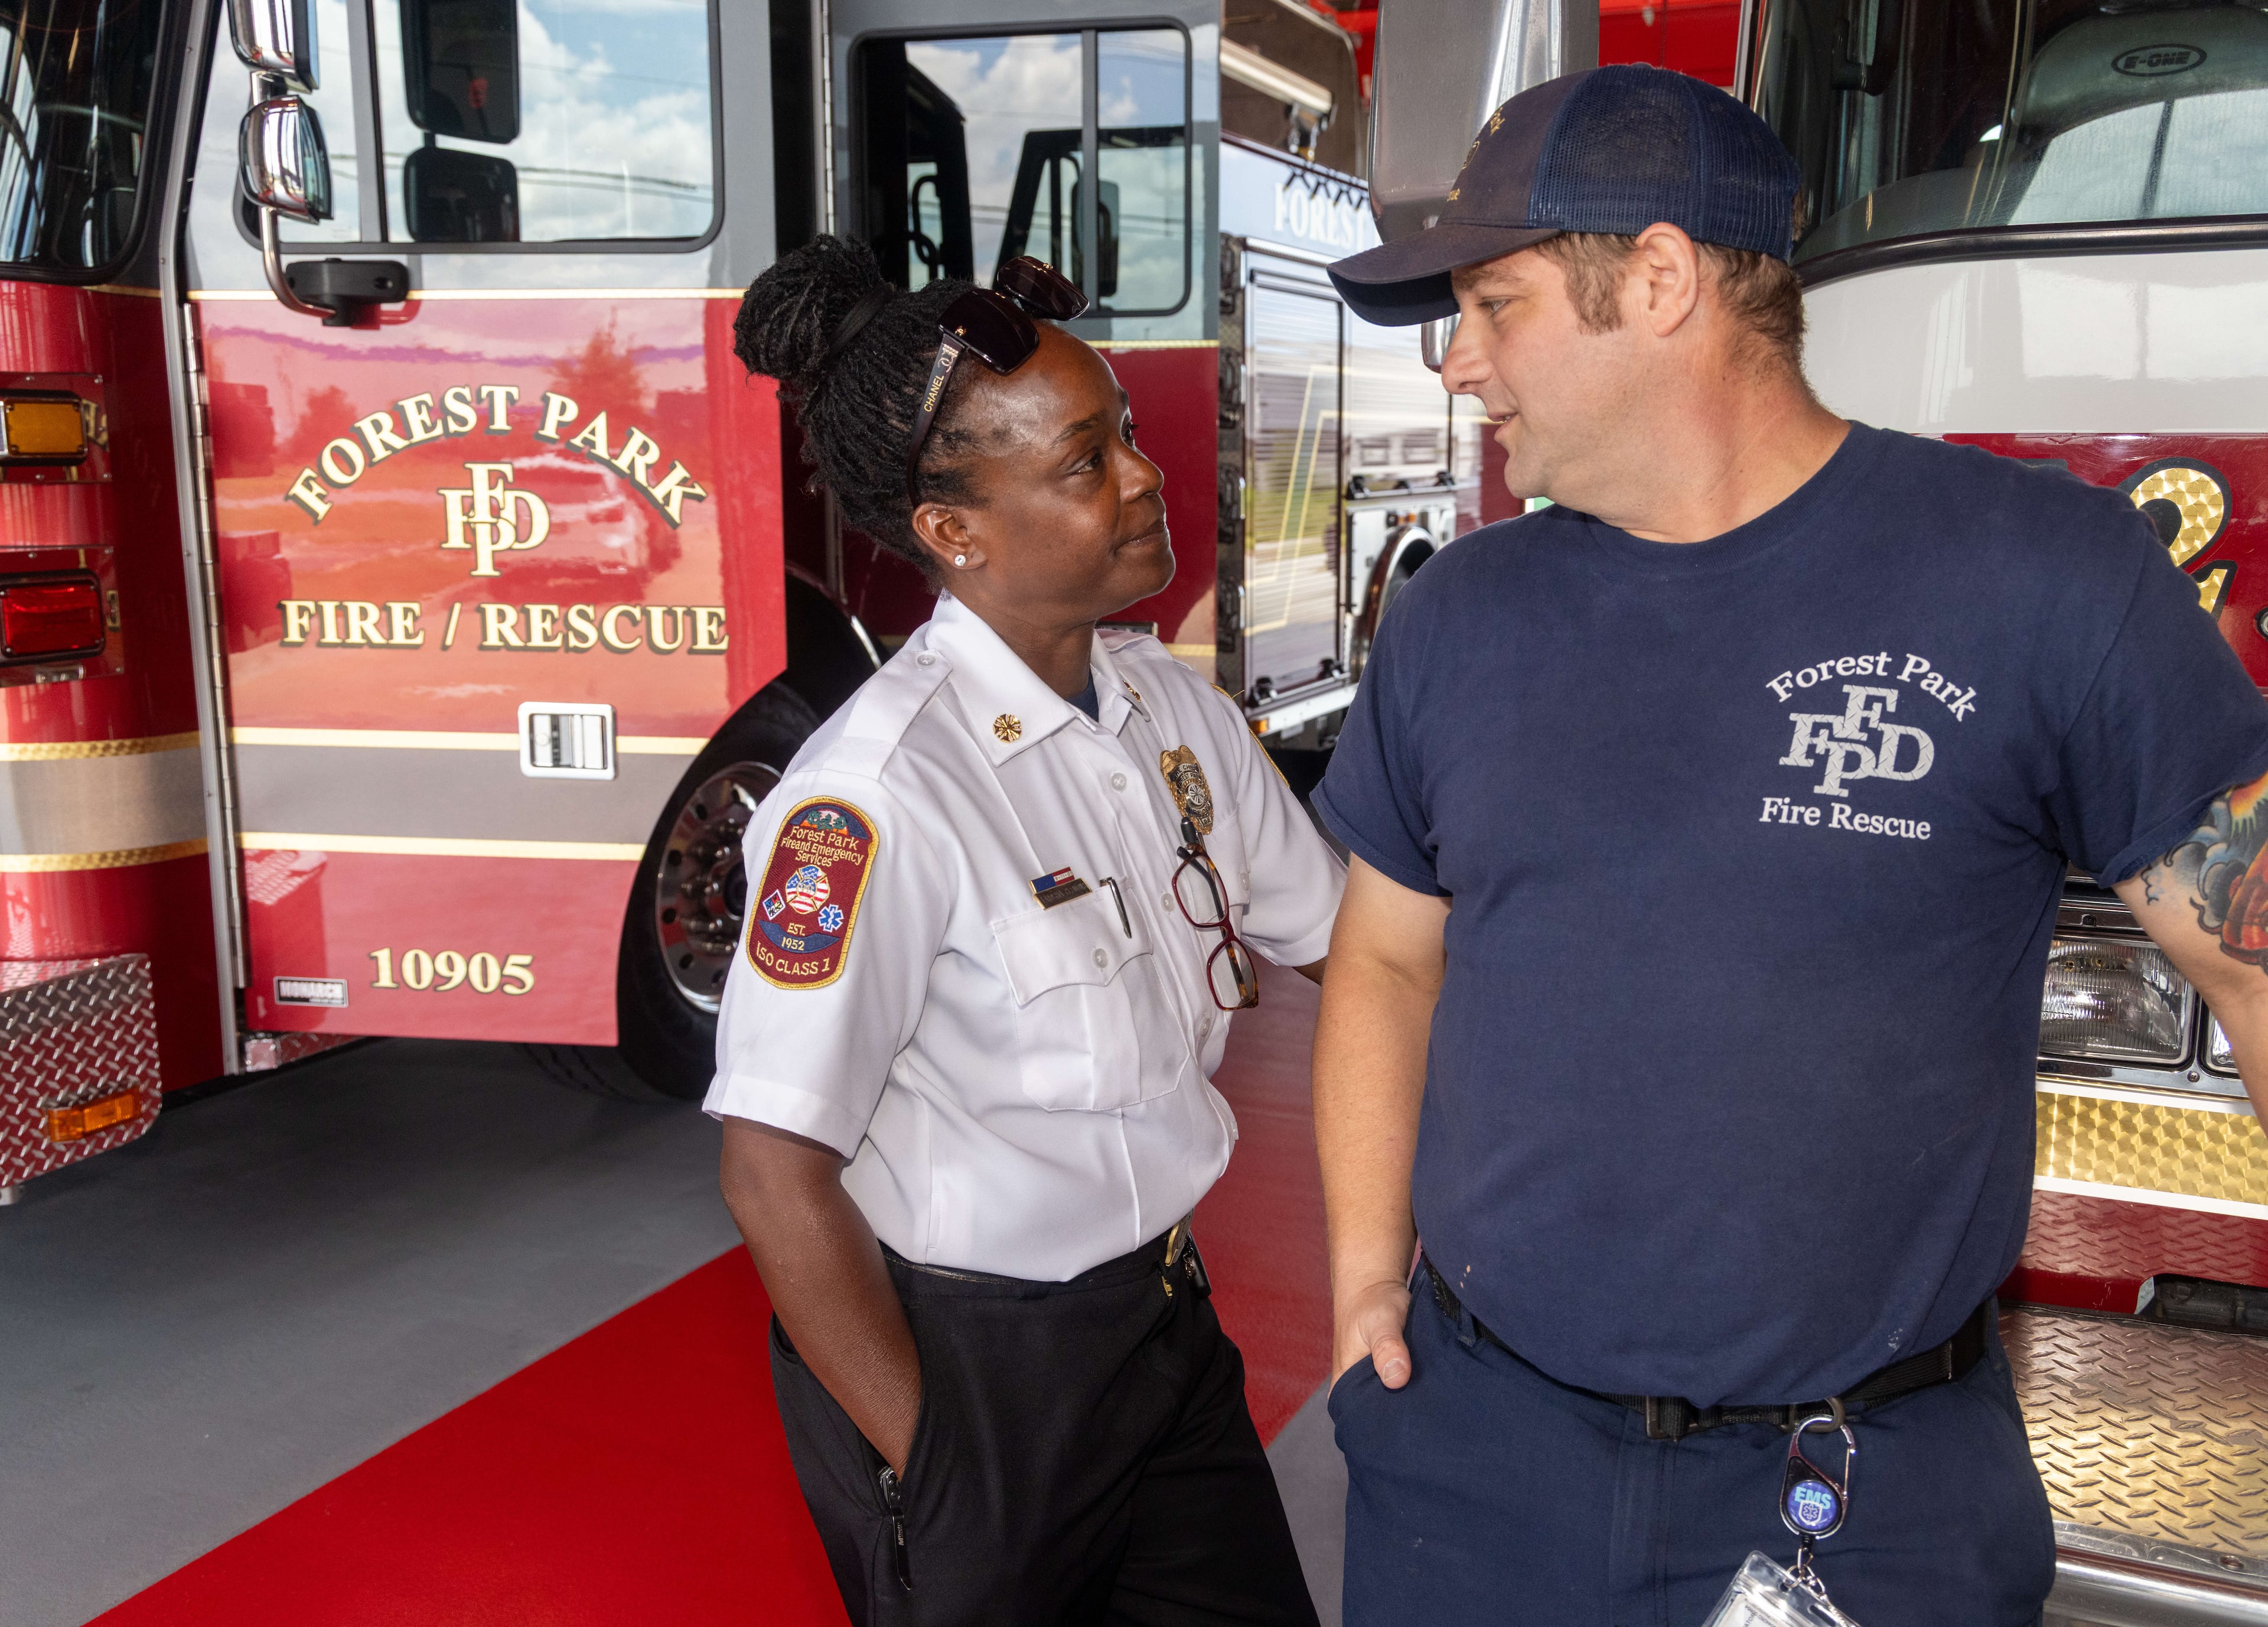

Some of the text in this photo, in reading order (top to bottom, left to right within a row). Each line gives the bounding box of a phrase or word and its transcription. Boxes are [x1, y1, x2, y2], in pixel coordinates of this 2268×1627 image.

[2123, 51, 2191, 69] E-ONE
[924, 375, 944, 412] CHANEL
[287, 385, 708, 526] FOREST PARK
[281, 600, 425, 647] FIRE
[479, 603, 729, 652] RESCUE
[1765, 652, 1976, 722] Forest Park
[1759, 797, 1931, 840] Fire Rescue
[790, 826, 860, 850] Forest Park
[811, 844, 864, 865] Emergency
[795, 851, 832, 867] Services
[756, 941, 830, 975] ISO CLASS 1
[781, 936, 804, 951] 1952
[370, 948, 535, 995] 10905
[1794, 1486, 1832, 1509] EMS
